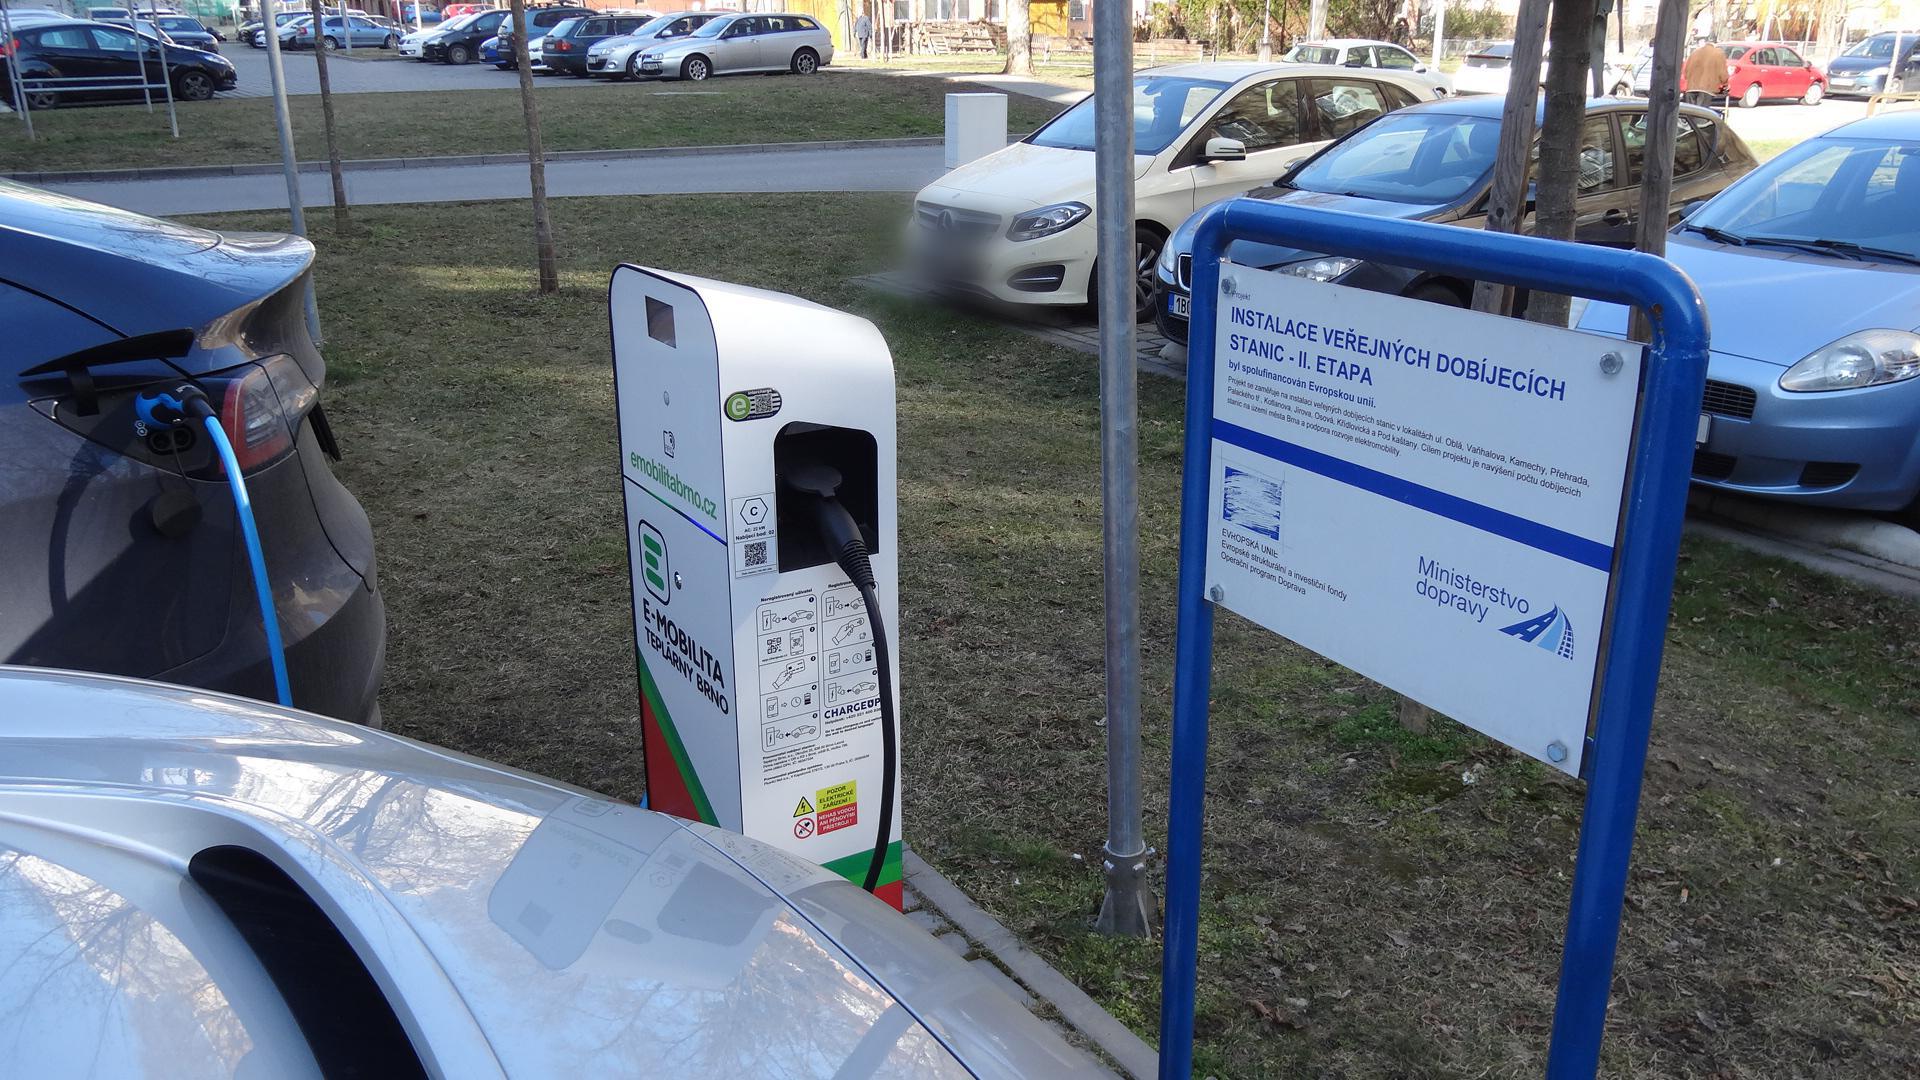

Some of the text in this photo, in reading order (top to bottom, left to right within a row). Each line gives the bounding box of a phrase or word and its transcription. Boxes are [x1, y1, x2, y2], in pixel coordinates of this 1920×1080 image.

[1231, 290, 1251, 300] Projekt
[1230, 333, 1285, 362] STANIC
[1298, 350, 1311, 370] II.
[1316, 355, 1373, 386] ETAPA
[1231, 306, 1566, 400] INSTALACE VEŘEJNÝCH DOBÍJECÍCH
[1228, 359, 1376, 408] byl spolufinancován Evropskou unii.
[1228, 375, 1246, 387] Projekt
[1254, 384, 1280, 398] zaměřuje
[1289, 394, 1312, 406] instalaci
[1313, 401, 1342, 415] veřejných
[1343, 409, 1374, 424] dobíjecích
[1376, 419, 1396, 430] stanic
[1402, 425, 1433, 441] lokalitách
[1445, 437, 1464, 451] Oblá,
[1509, 455, 1548, 475] Kamechy,
[1550, 467, 1590, 488] Přehrada,
[1228, 386, 1254, 400] Palackého
[1377, 430, 1391, 441] Pod
[1421, 443, 1441, 456] Cílem
[1442, 451, 1471, 465] projektu
[1472, 459, 1479, 468] je
[1481, 461, 1515, 478] navýšení
[1516, 472, 1538, 485] počtu
[1540, 479, 1582, 498] dobíjecích
[1243, 402, 1250, 410] na
[1268, 409, 1285, 421] města
[1286, 415, 1300, 426] Brna
[1306, 422, 1330, 435] podpora
[1331, 429, 1353, 442] rozvoje
[630, 451, 717, 520] emobilitabrno.cz
[750, 506, 758, 516] C
[1220, 551, 1306, 595] Operační program Doprava
[1221, 539, 1347, 601] Evropské strukturální a investiční fondy
[1418, 556, 1529, 614] Ministerstvo
[1416, 578, 1489, 623] dopravy
[643, 597, 725, 689] E-MOBILITA
[645, 626, 729, 715] TEPLÁRNY BRNO
[824, 697, 881, 719] CHARGEUP
[819, 789, 854, 803] ELEKTRICKÉ
[826, 785, 846, 795] POZOR
[837, 806, 856, 816] VODOU
